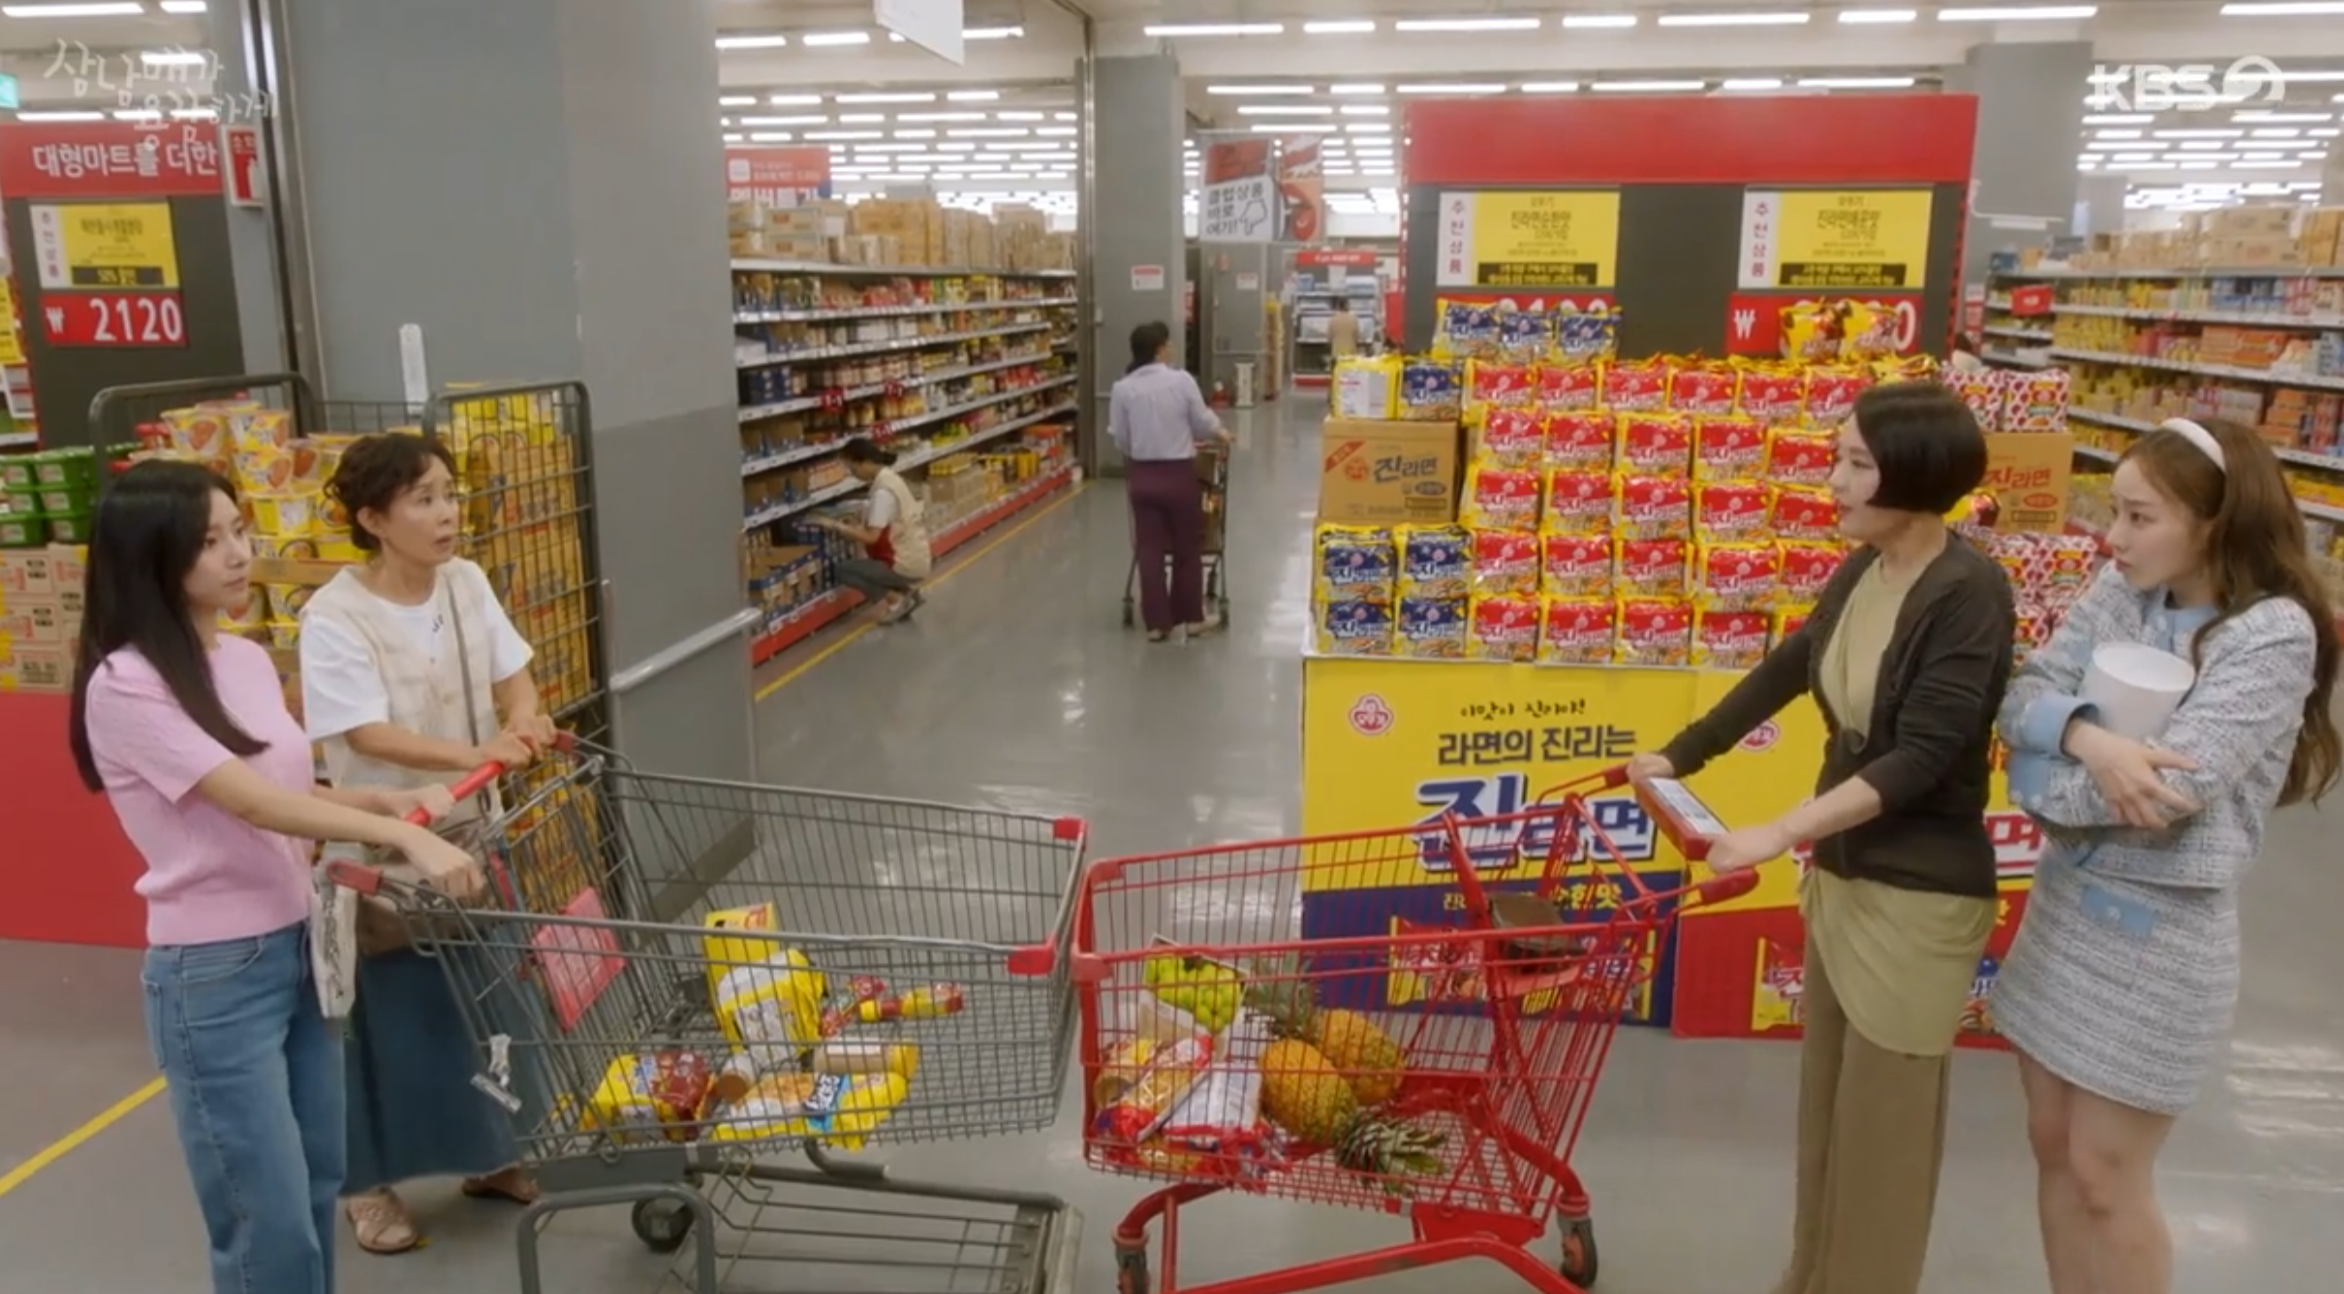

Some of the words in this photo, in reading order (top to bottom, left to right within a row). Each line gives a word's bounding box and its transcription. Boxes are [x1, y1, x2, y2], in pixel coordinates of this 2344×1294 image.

[33, 143, 159, 178] 대형마트를
[166, 142, 217, 176] 더한
[90, 298, 182, 341] 2120
[1374, 455, 1437, 483] 진라면
[1982, 467, 2052, 492] 진라면
[1438, 731, 1533, 765] 라면의
[1541, 725, 1637, 762] 진리는
[1412, 772, 1656, 872] 진라면
